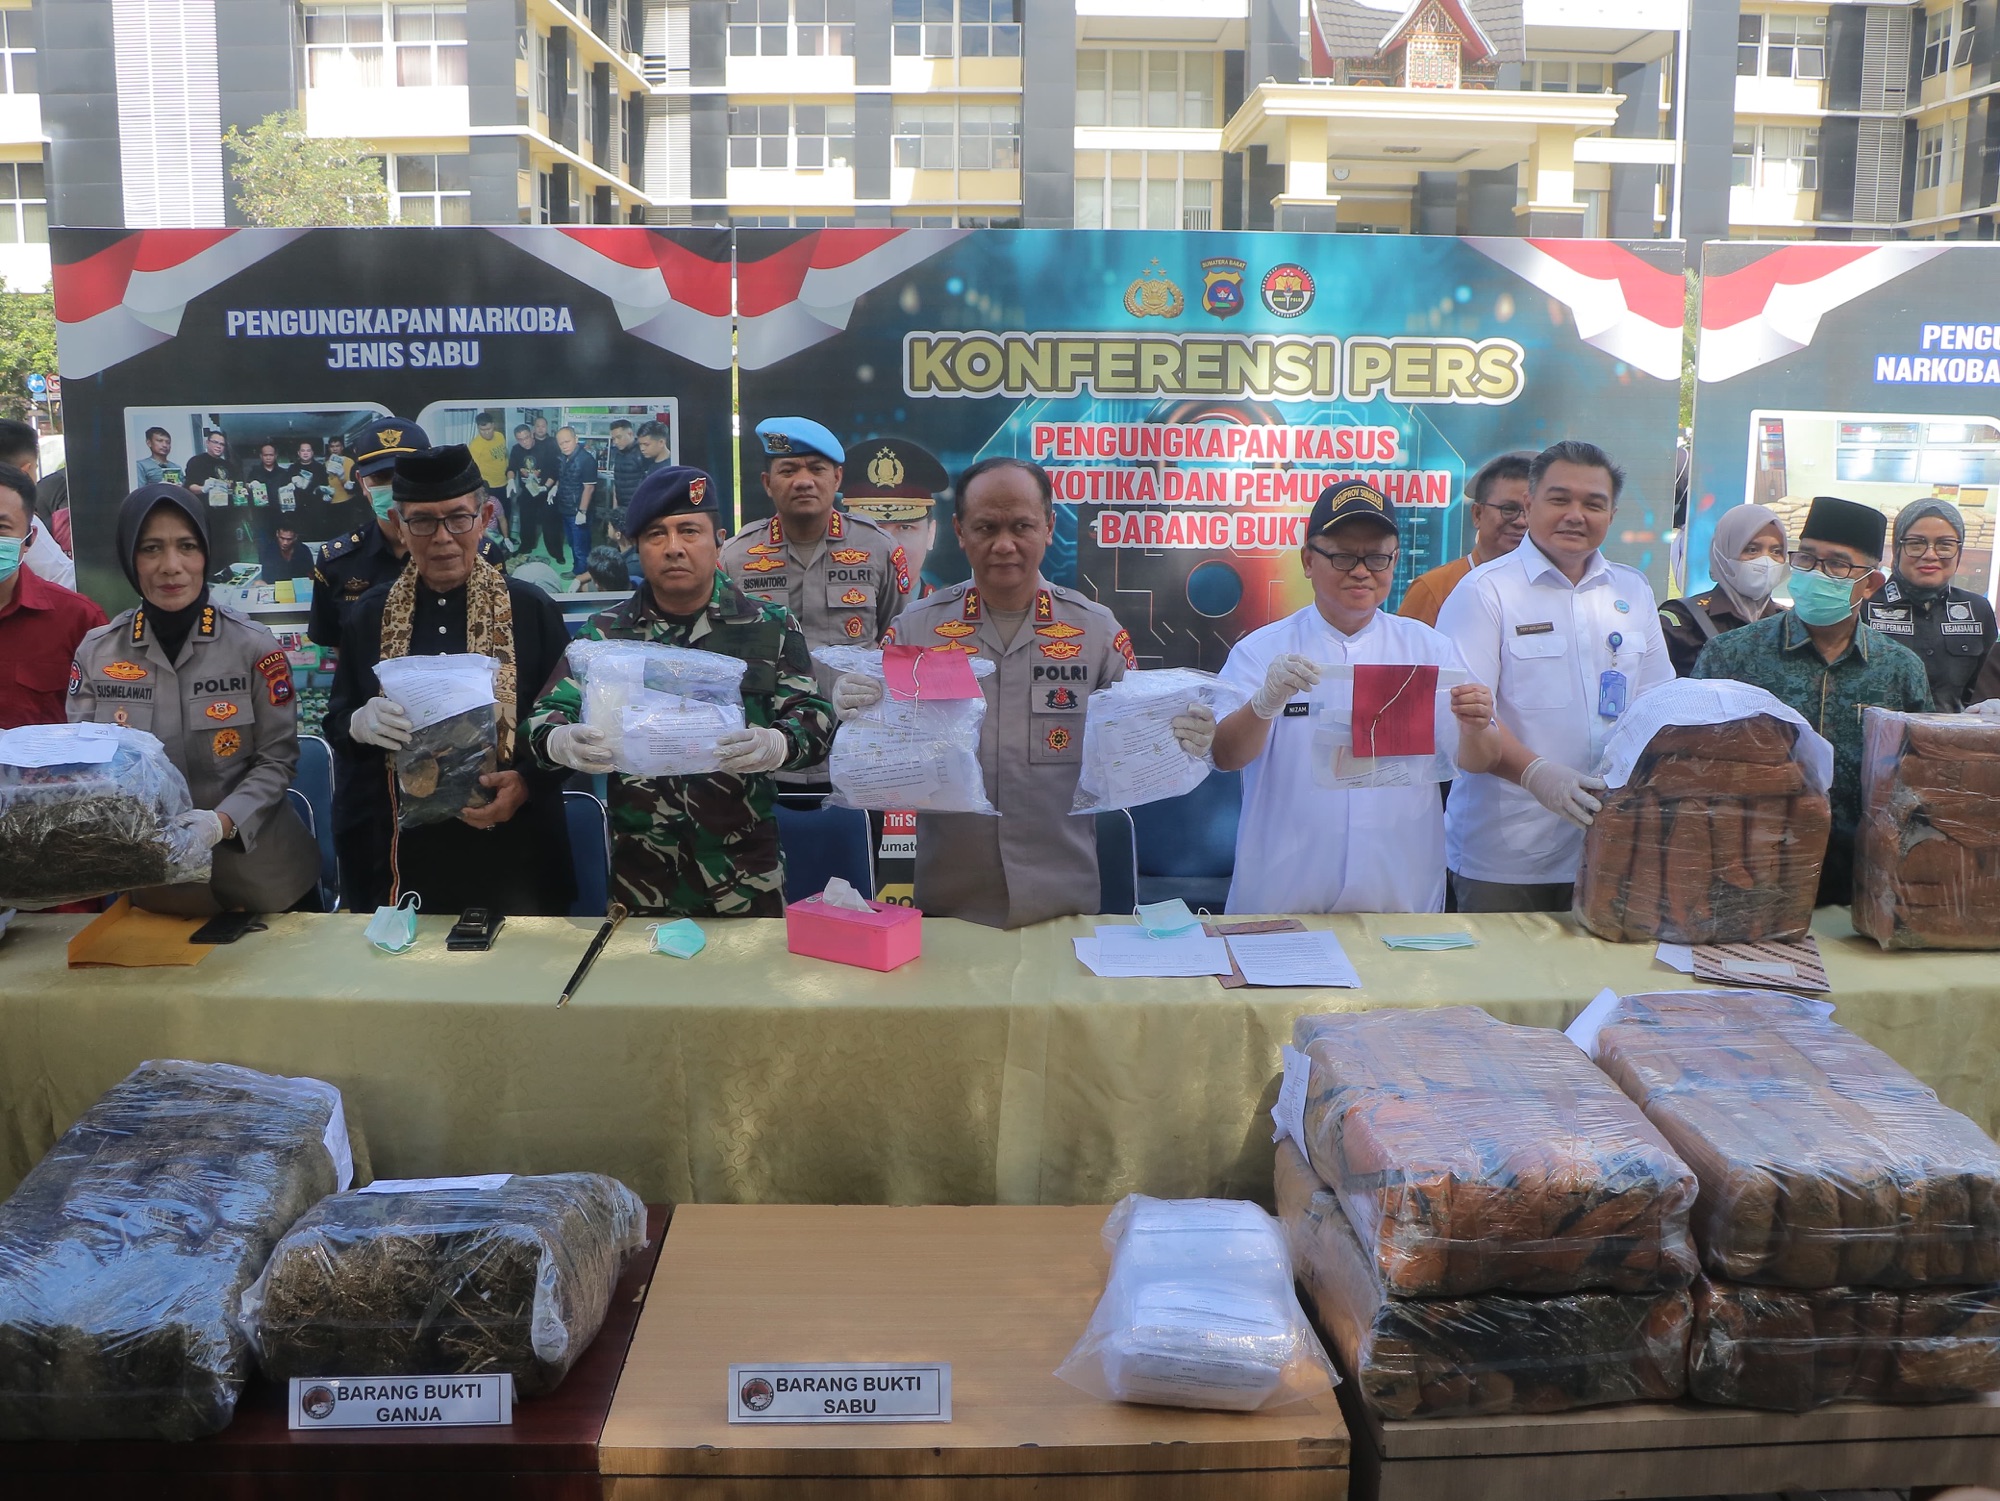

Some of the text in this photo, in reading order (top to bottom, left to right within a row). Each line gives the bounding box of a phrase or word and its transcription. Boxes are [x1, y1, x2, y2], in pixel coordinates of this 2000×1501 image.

[227, 306, 574, 337] PENGUNGKAPAN NARKOBA
[327, 340, 480, 368] JENIS SABU
[908, 335, 1519, 399] KONFERENSI PERS
[1876, 356, 2000, 384] NARKOBA
[1035, 425, 1395, 462] PENGUNGKAPAN KASUS
[1163, 471, 1227, 502] DAN
[1234, 472, 1447, 504] PEMUHAN
[1101, 514, 1229, 546] BARANG
[743, 575, 787, 590] SISWANTORO
[828, 569, 871, 582] POLRI
[259, 652, 285, 670] POLDA
[1033, 665, 1088, 681] POLRI
[97, 684, 153, 700] SUSMELAWATI
[193, 676, 247, 696] POLRI
[889, 814, 904, 827] Tri
[881, 842, 917, 852] umat
[337, 1385, 418, 1402] BARANG
[424, 1383, 482, 1400] BUKTI
[776, 1377, 858, 1391] BARANG
[863, 1376, 921, 1391] BUKTI
[376, 1406, 443, 1423] GANJA
[823, 1398, 877, 1414] SABU
